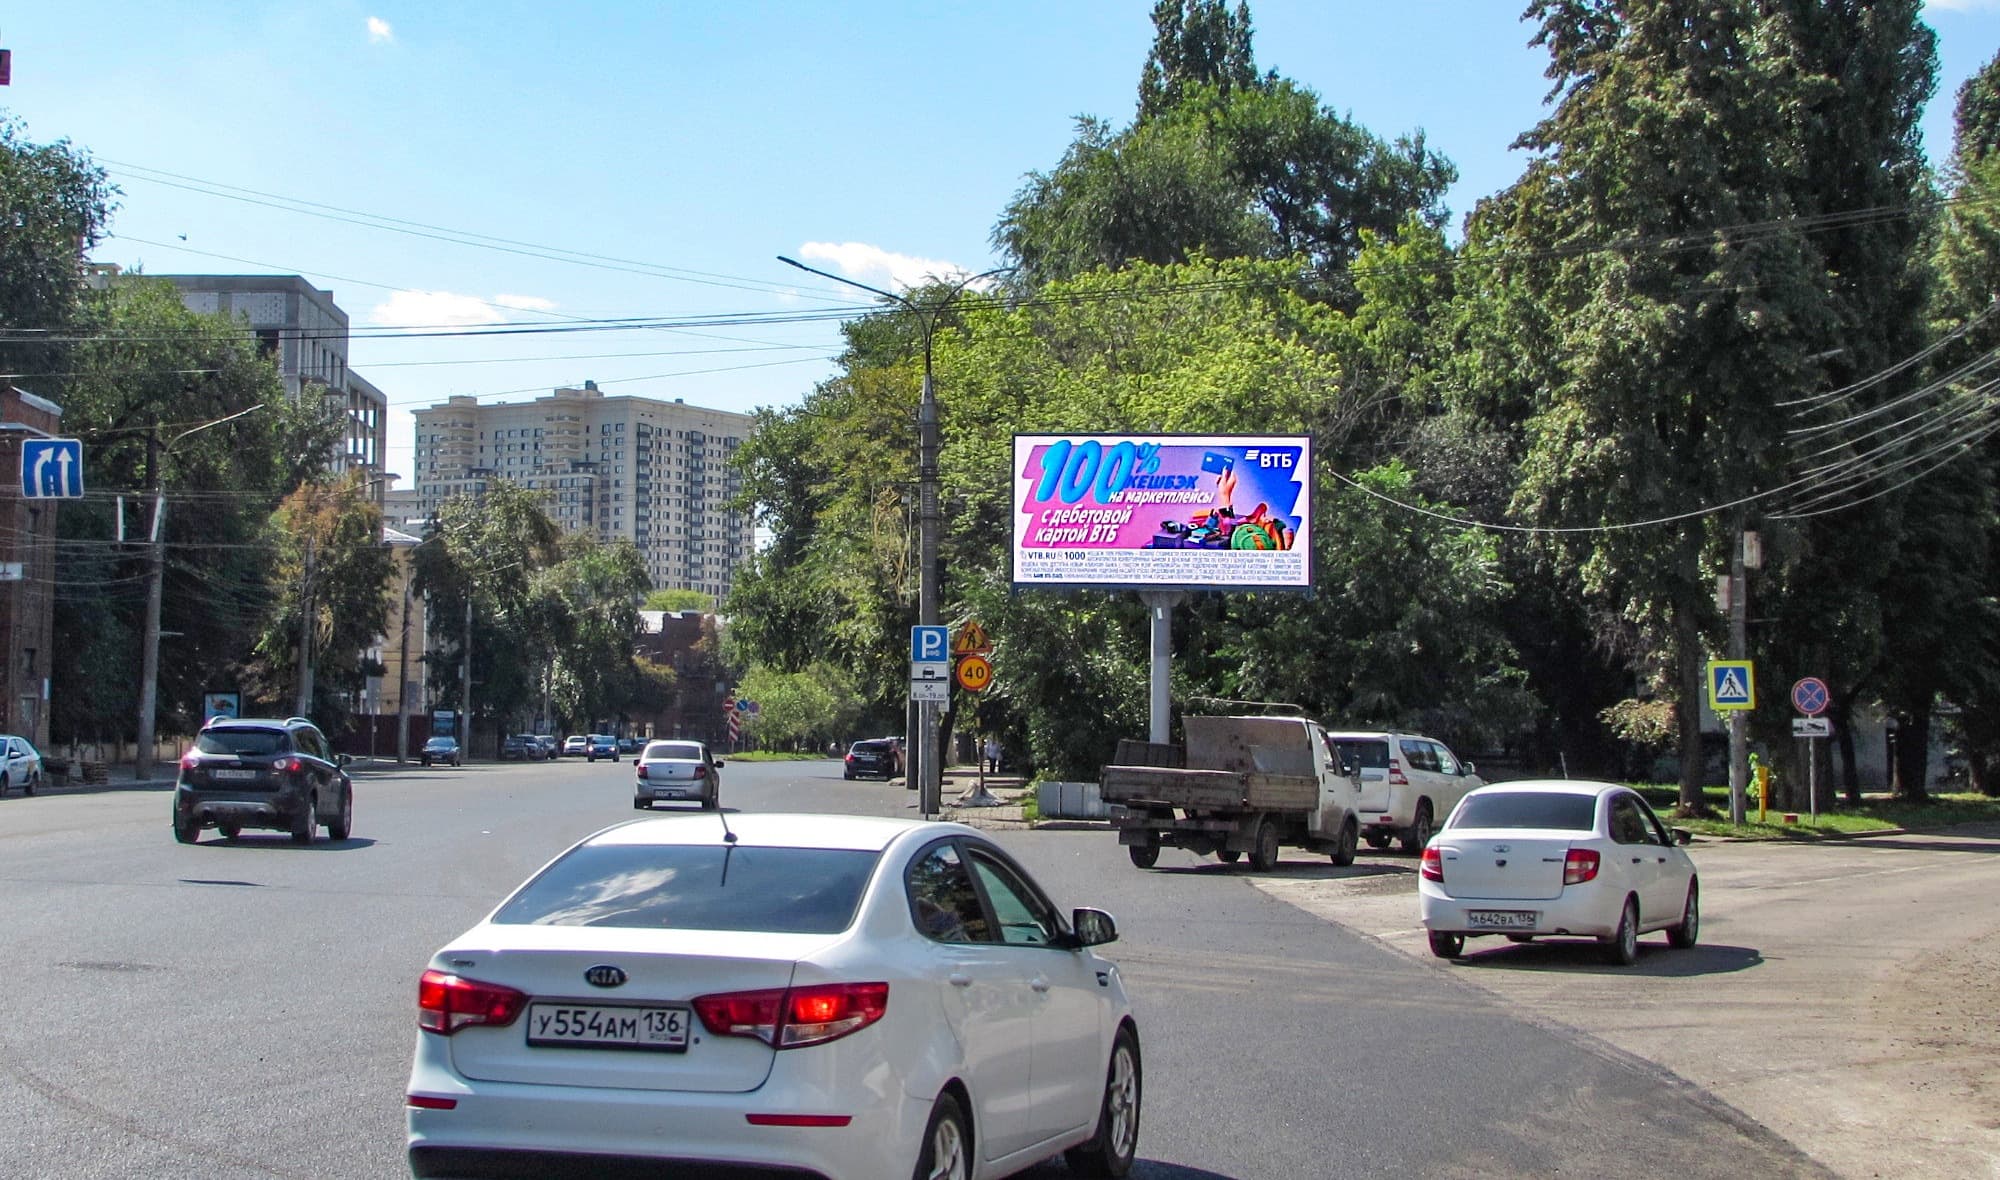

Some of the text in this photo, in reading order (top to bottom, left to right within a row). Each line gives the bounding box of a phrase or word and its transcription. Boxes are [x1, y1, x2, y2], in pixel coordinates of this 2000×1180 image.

[1260, 453, 1293, 468] ВТБ
[1035, 439, 1161, 504] 100%
[1123, 475, 1199, 489] КЕШБЭК
[1108, 489, 1215, 506] на маркетплейсы
[1041, 504, 1132, 526] с дебетовой
[1035, 523, 1119, 546] картой ВТБ
[1028, 551, 1056, 560] VTB.RU
[1064, 551, 1086, 560] 1000
[921, 630, 942, 659] P
[964, 666, 985, 680] 40
[589, 969, 620, 984] KIA
[539, 1009, 681, 1038] У554АМ 136
